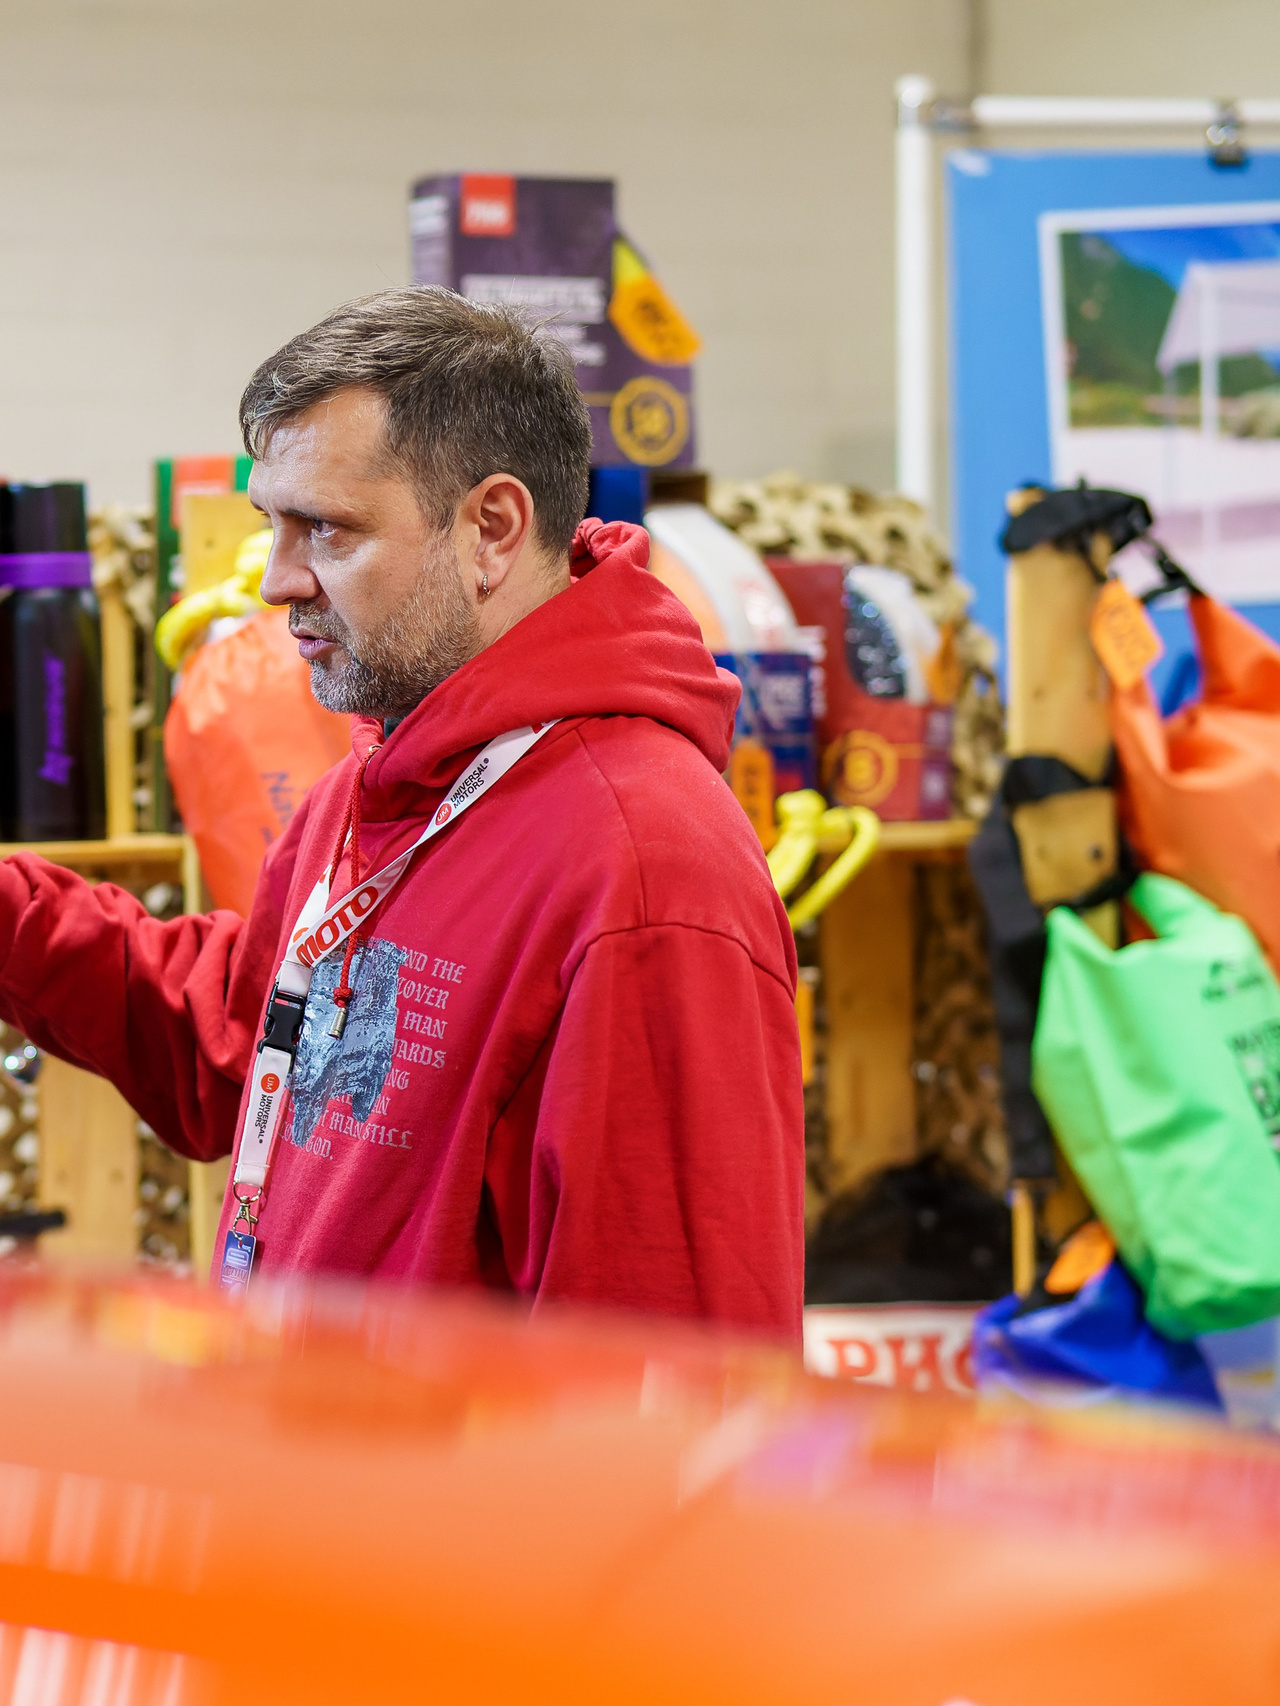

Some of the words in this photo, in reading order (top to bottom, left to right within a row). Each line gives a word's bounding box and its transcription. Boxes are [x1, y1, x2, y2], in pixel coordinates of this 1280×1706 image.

[453, 777, 485, 809] MOTORS
[431, 958, 467, 984] THE
[402, 1010, 448, 1040] MAN
[255, 1094, 267, 1127] MOTORS
[362, 1123, 413, 1150] STILL
